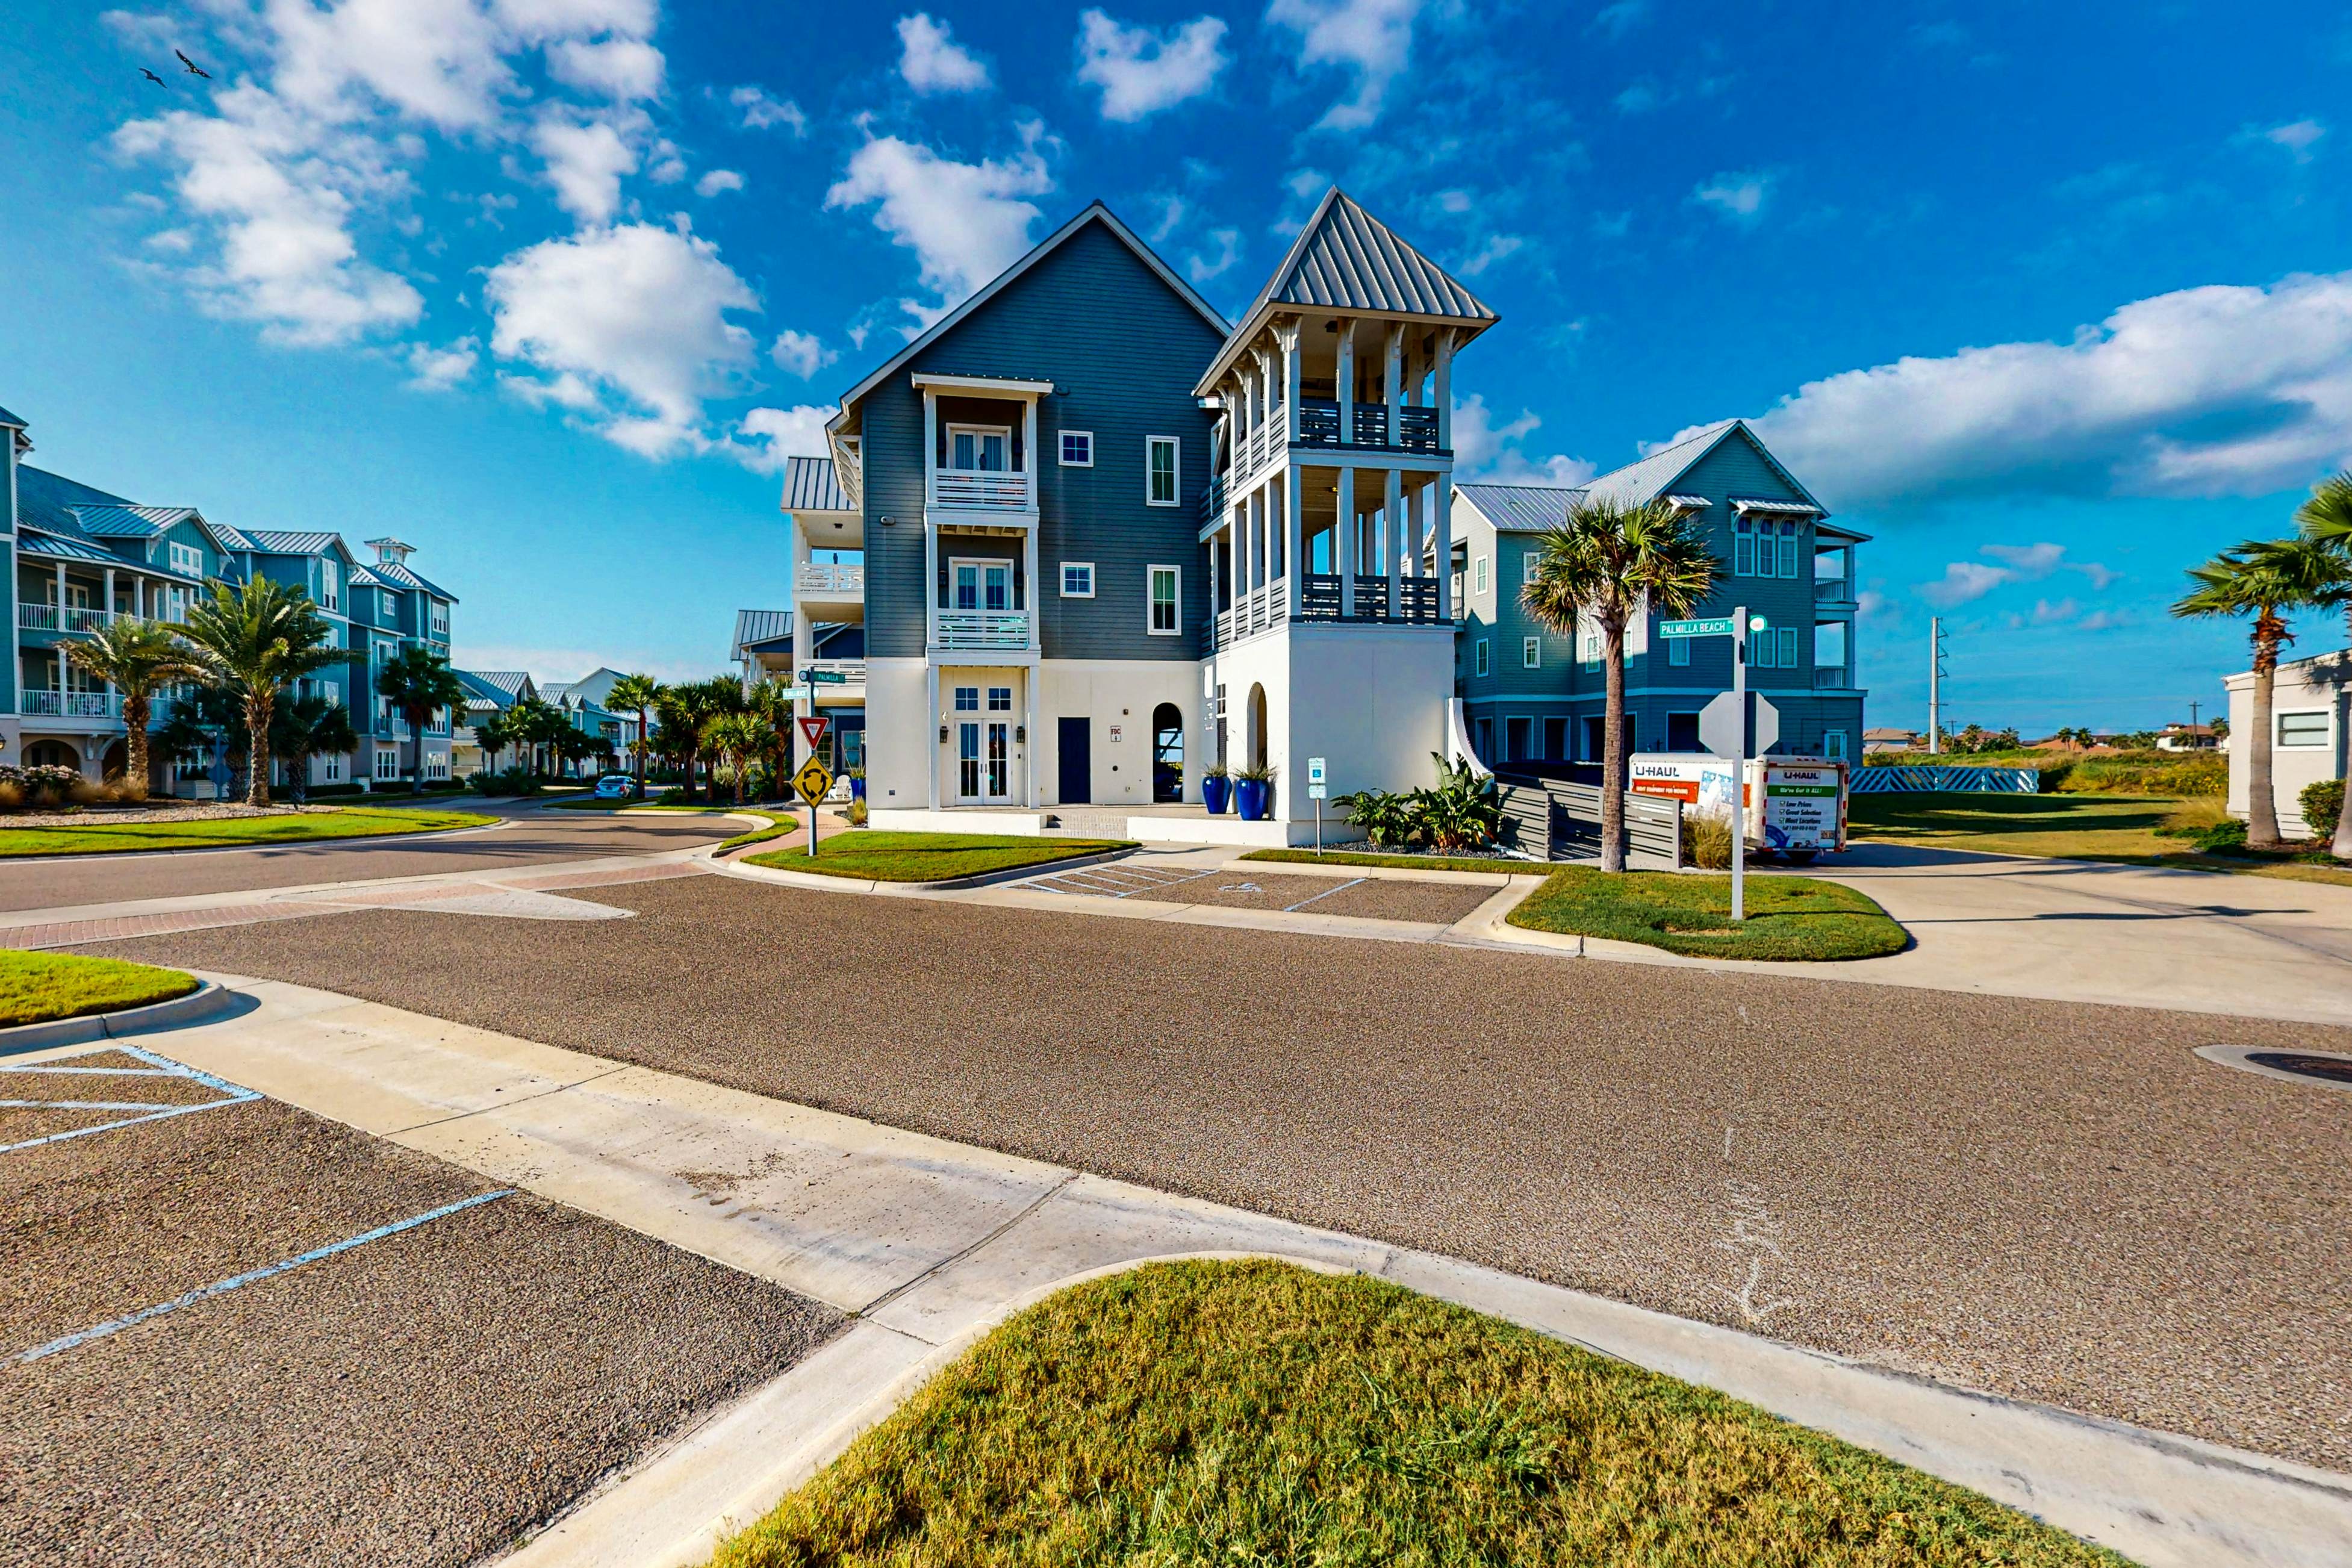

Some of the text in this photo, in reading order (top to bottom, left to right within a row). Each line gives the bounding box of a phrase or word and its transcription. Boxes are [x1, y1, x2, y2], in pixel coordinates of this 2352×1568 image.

[1661, 621, 1725, 634] PALMILLA BEACH
[1636, 766, 1679, 777] U-HAUL
